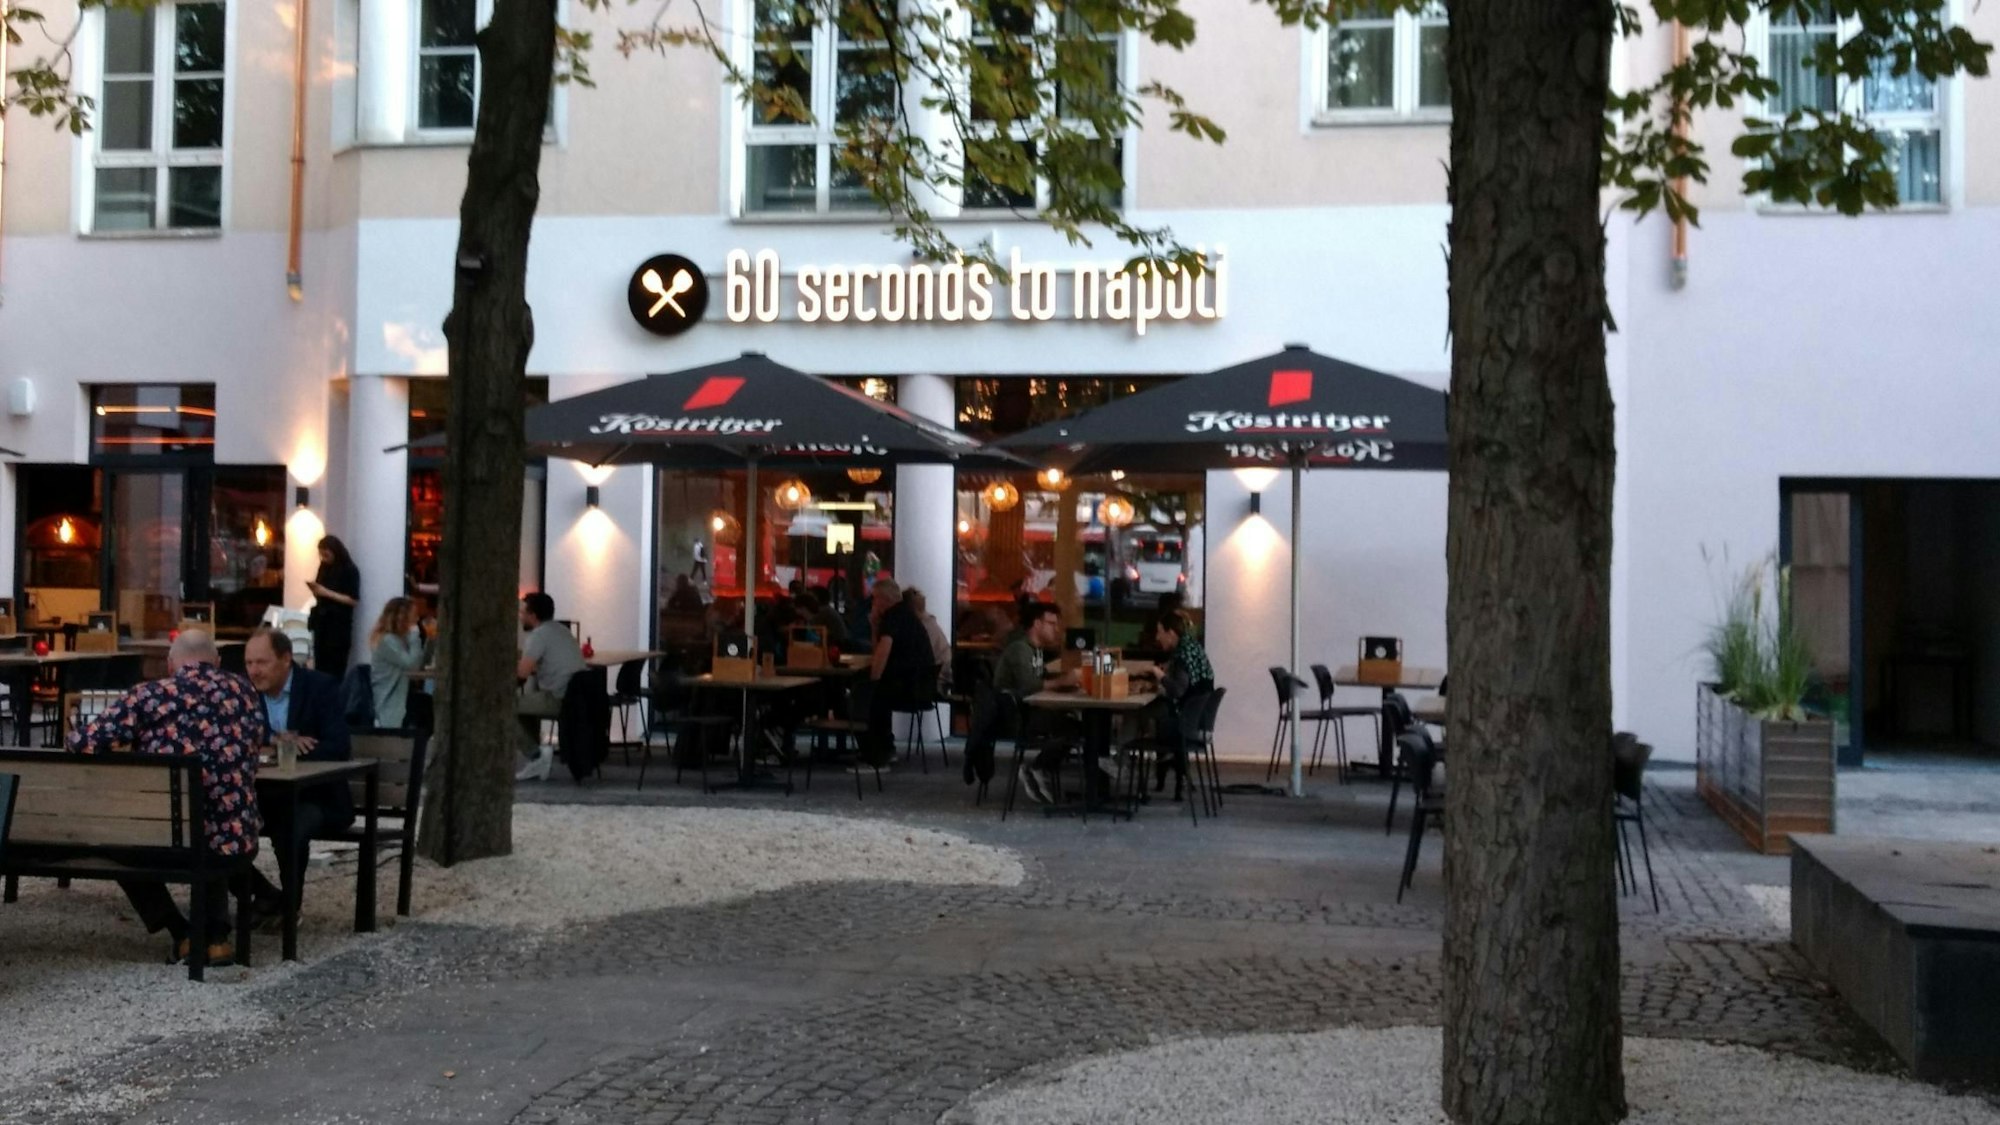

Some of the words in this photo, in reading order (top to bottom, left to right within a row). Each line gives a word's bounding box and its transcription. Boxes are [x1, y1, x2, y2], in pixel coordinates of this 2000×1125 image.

[726, 248, 779, 322] 60
[797, 247, 993, 322] seconds
[1010, 245, 1056, 320] to
[1073, 242, 1227, 336] napoli
[1185, 410, 1391, 432] Köstritzer
